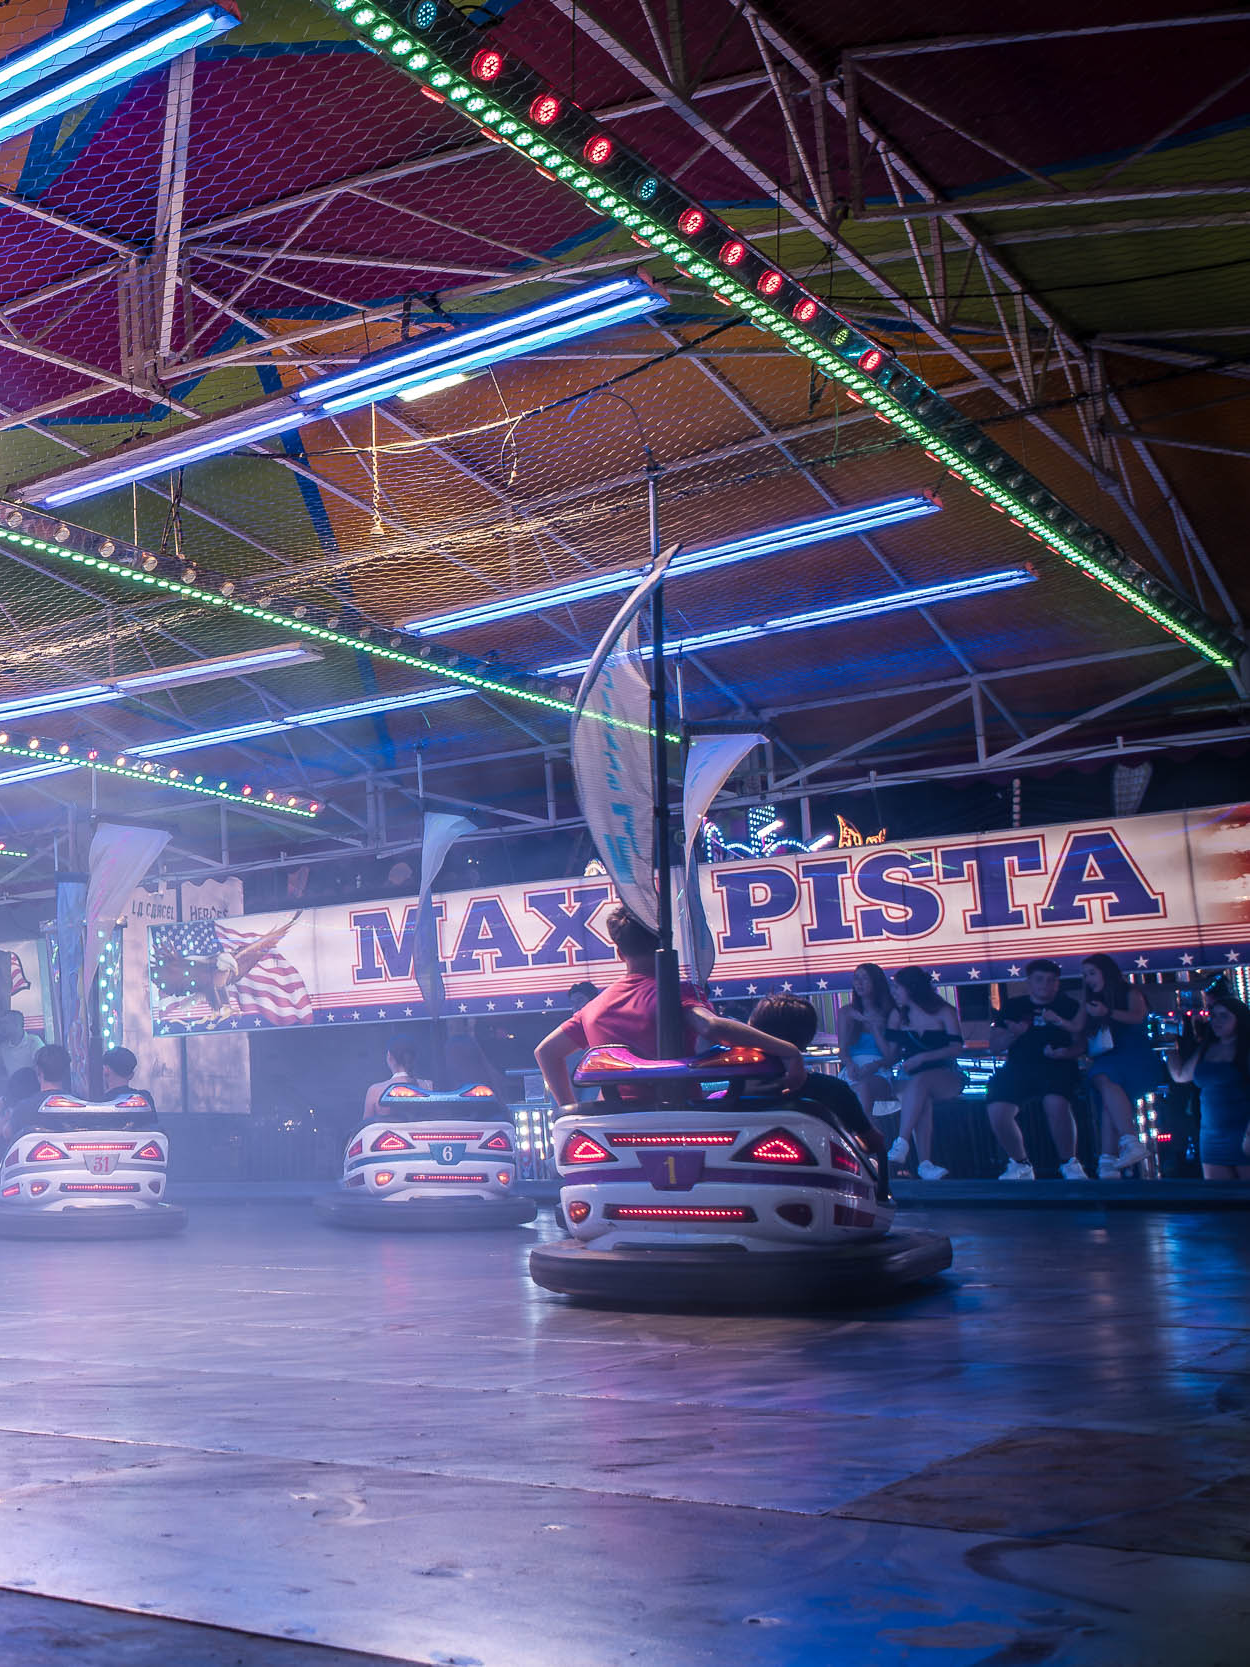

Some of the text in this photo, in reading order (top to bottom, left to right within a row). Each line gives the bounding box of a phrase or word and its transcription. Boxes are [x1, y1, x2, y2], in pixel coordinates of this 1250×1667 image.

[350, 826, 1168, 985] MAX PISTA
[442, 1145, 453, 1162] 6
[663, 1156, 677, 1185] 1
